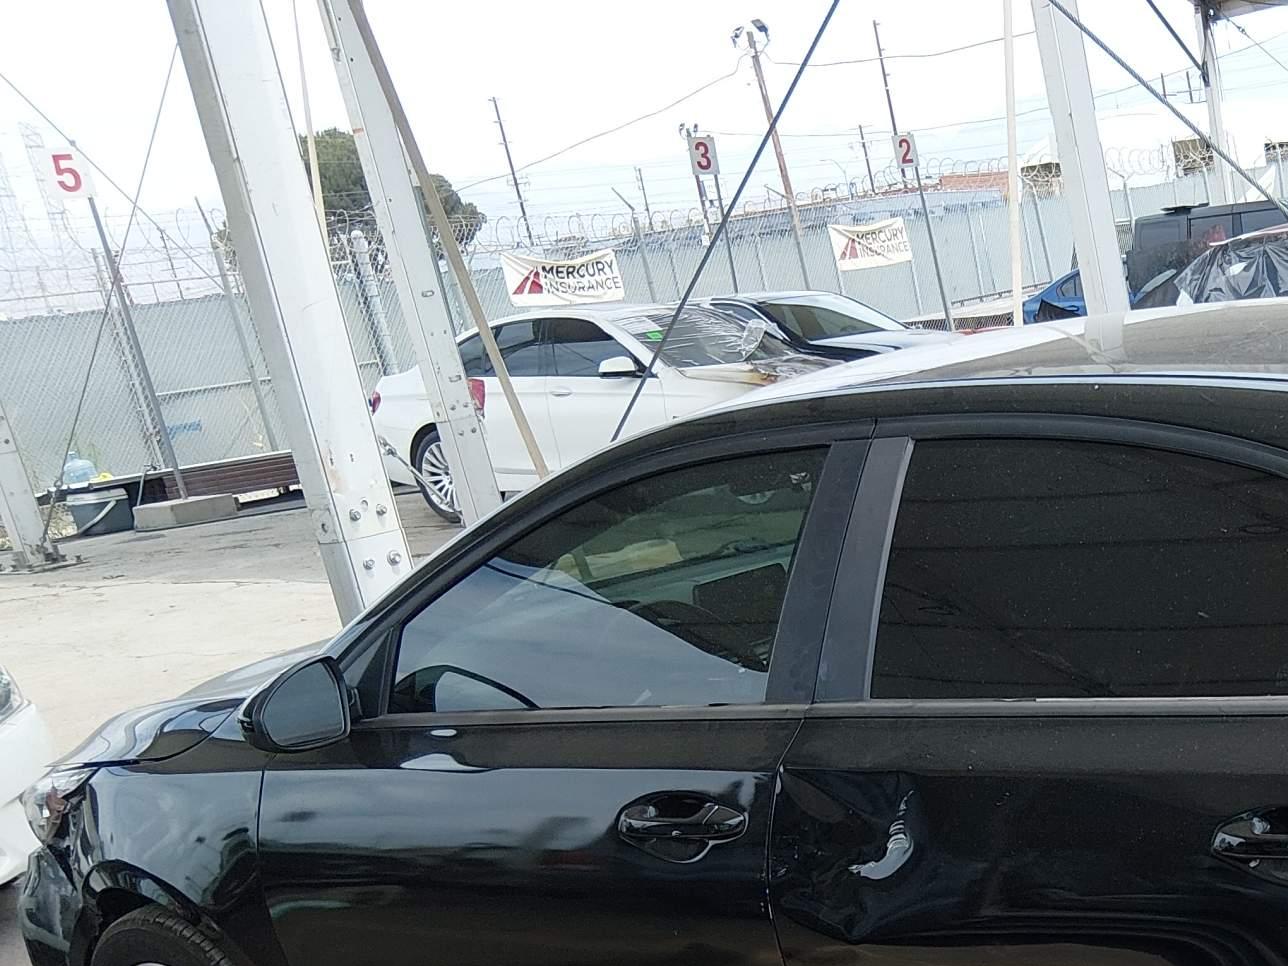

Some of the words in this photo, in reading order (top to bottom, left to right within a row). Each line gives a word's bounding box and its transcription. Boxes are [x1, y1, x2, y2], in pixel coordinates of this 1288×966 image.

[694, 141, 712, 171] 3
[898, 138, 914, 165] 2
[52, 153, 82, 193] 5
[856, 226, 904, 245] MERCURY
[541, 259, 615, 280] MERCURY
[544, 276, 622, 294] INSURANCE
